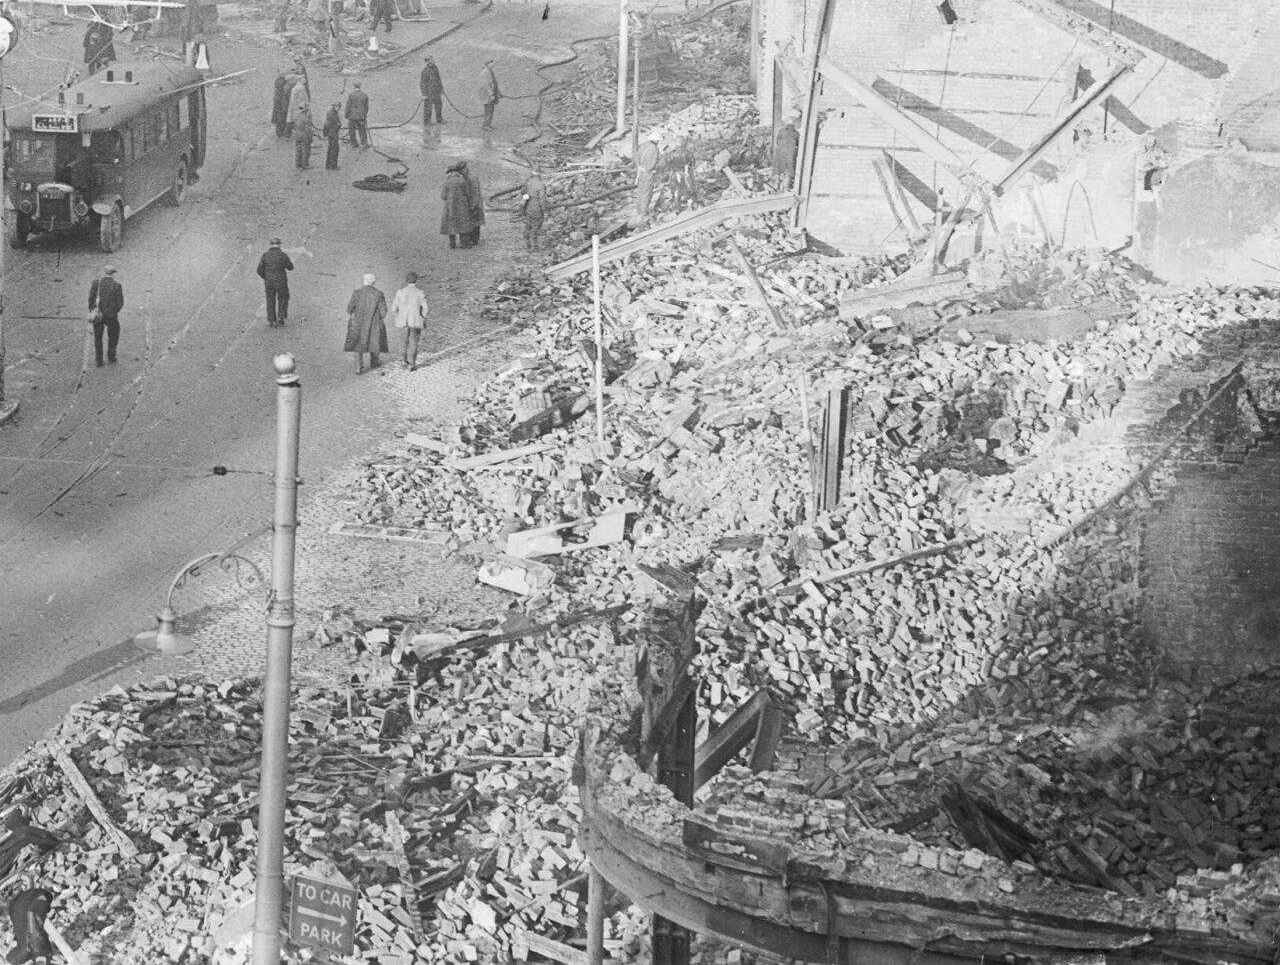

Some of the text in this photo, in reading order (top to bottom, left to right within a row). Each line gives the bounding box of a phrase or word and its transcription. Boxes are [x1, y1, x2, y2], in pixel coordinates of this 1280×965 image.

[296, 881, 352, 911] TO CAR
[300, 921, 343, 948] PARK
